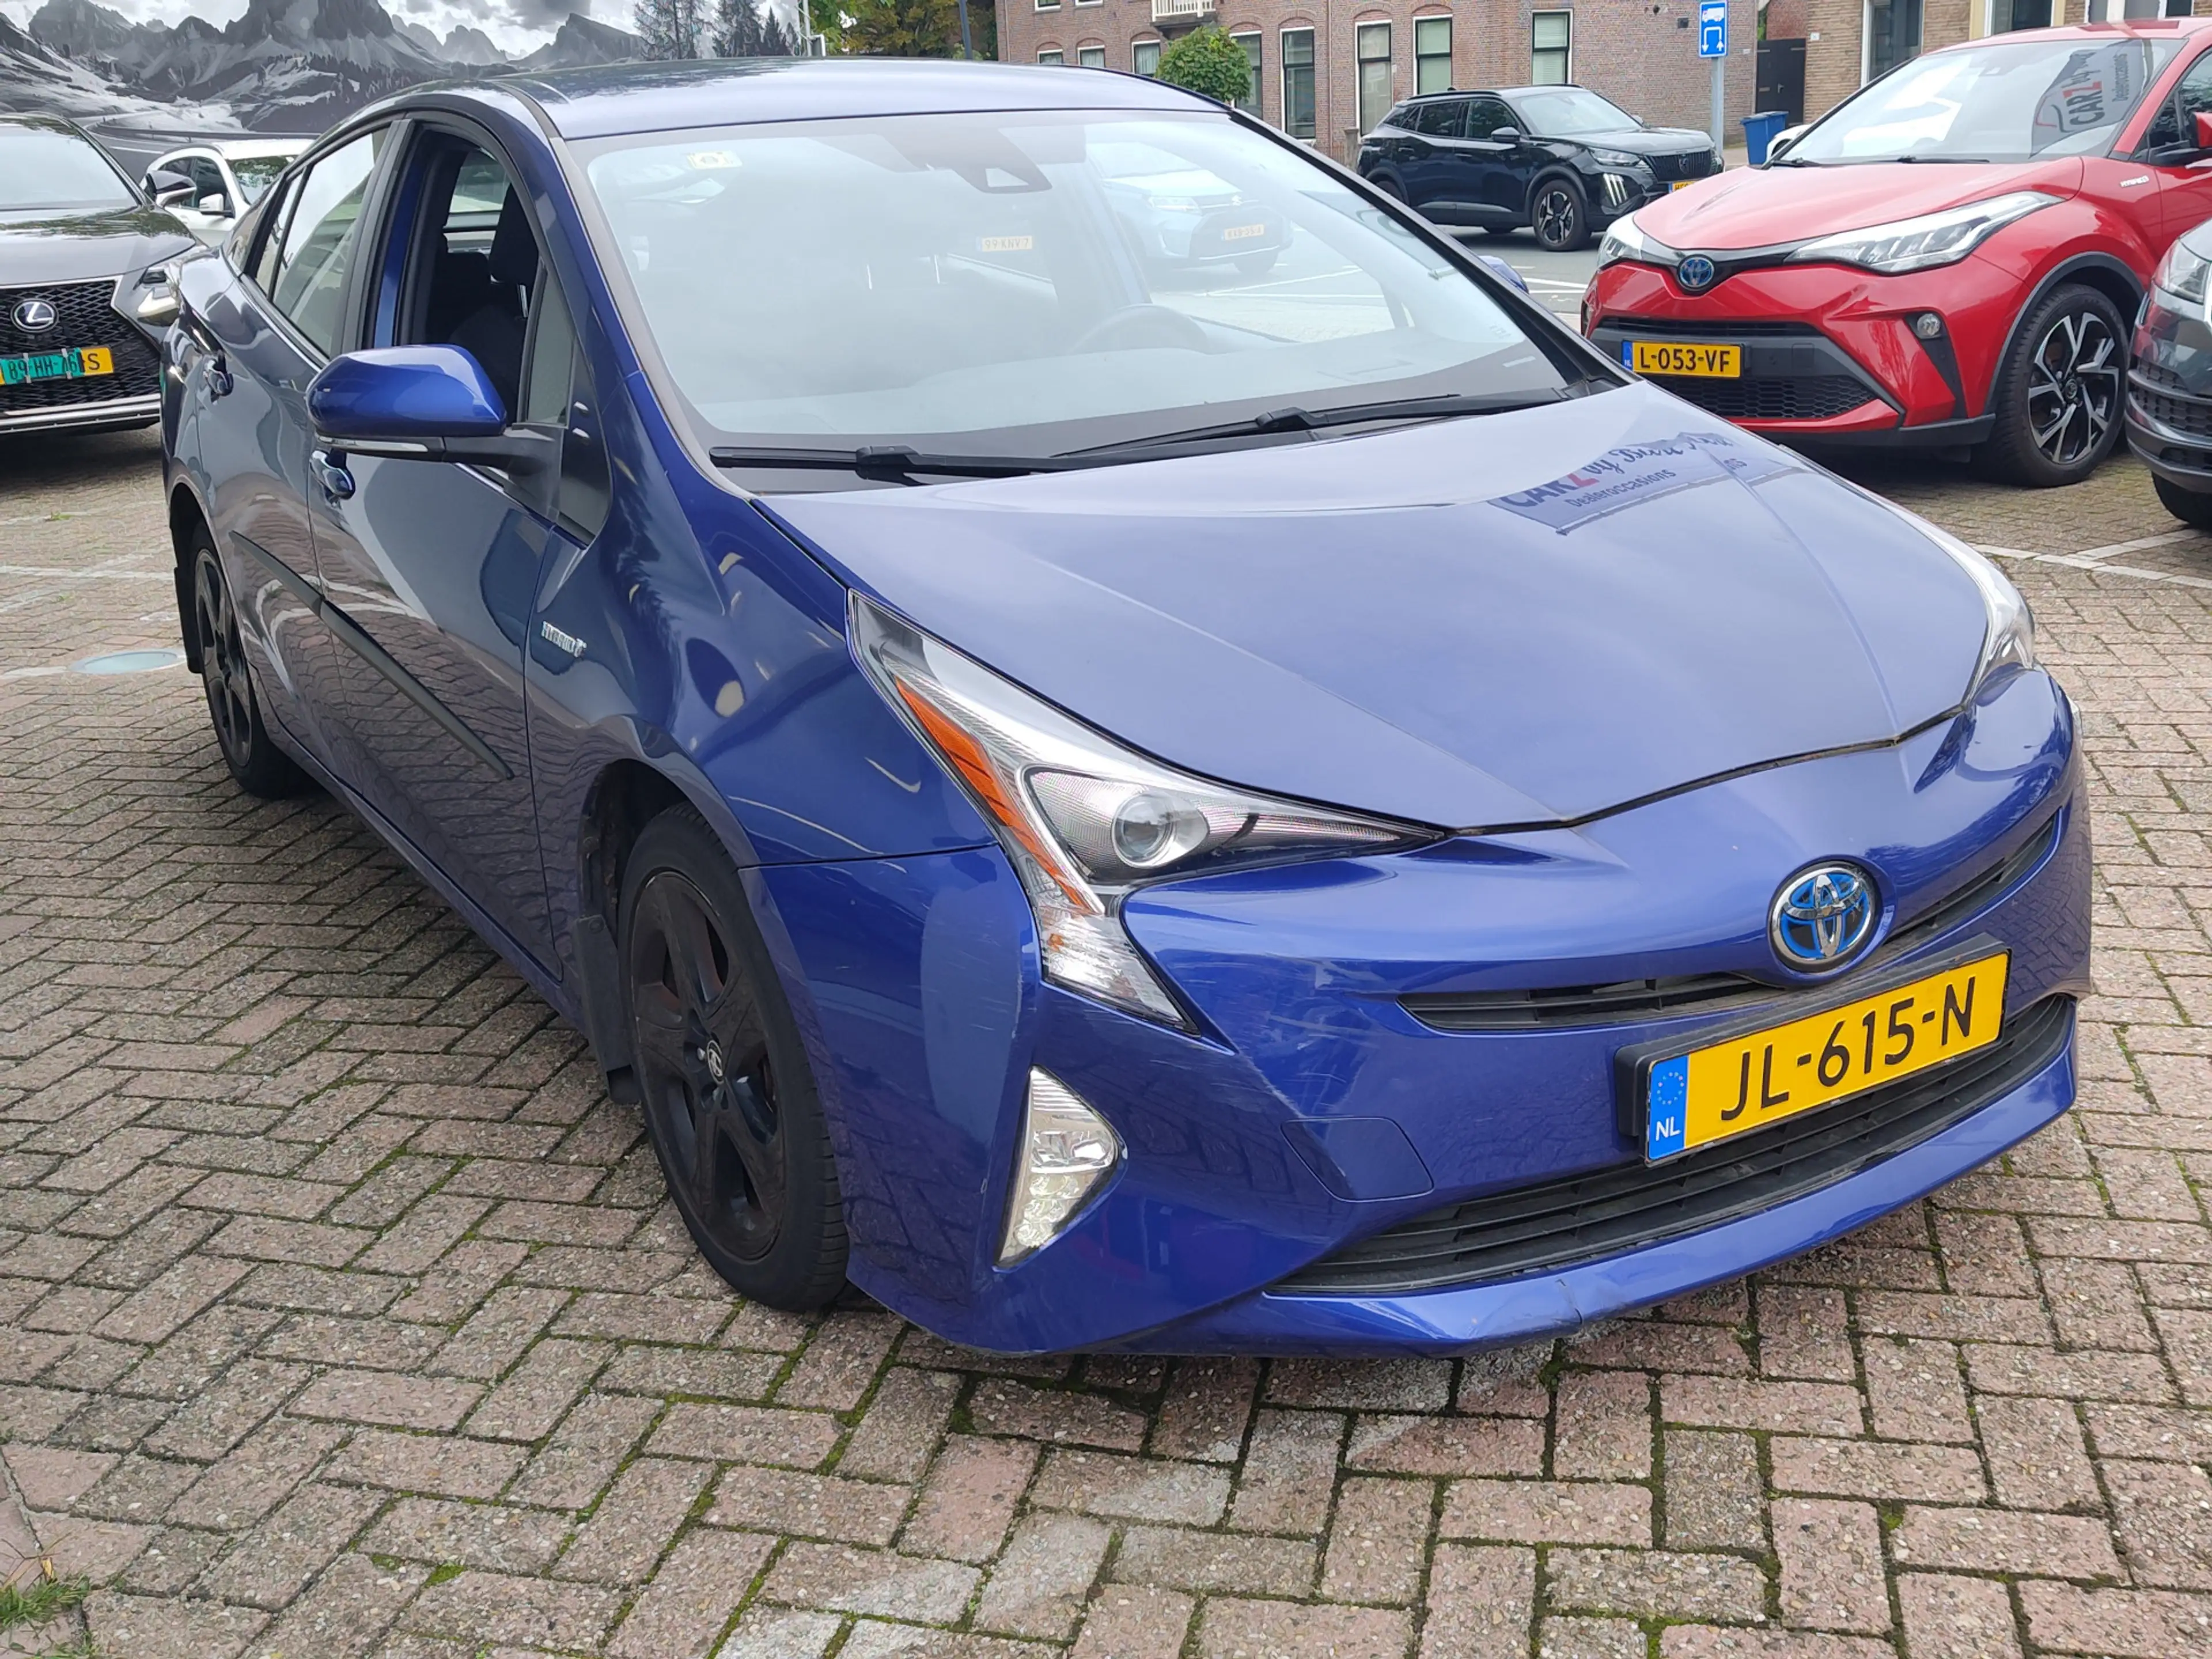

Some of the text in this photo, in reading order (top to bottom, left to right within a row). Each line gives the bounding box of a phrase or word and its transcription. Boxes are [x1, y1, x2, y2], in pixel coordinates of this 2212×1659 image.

[1640, 347, 1731, 372] L-053-VF
[1563, 468, 1677, 507] Dealeroccasions
[1721, 976, 1976, 1121] JL-615-N
[1654, 1116, 1682, 1141] NL
